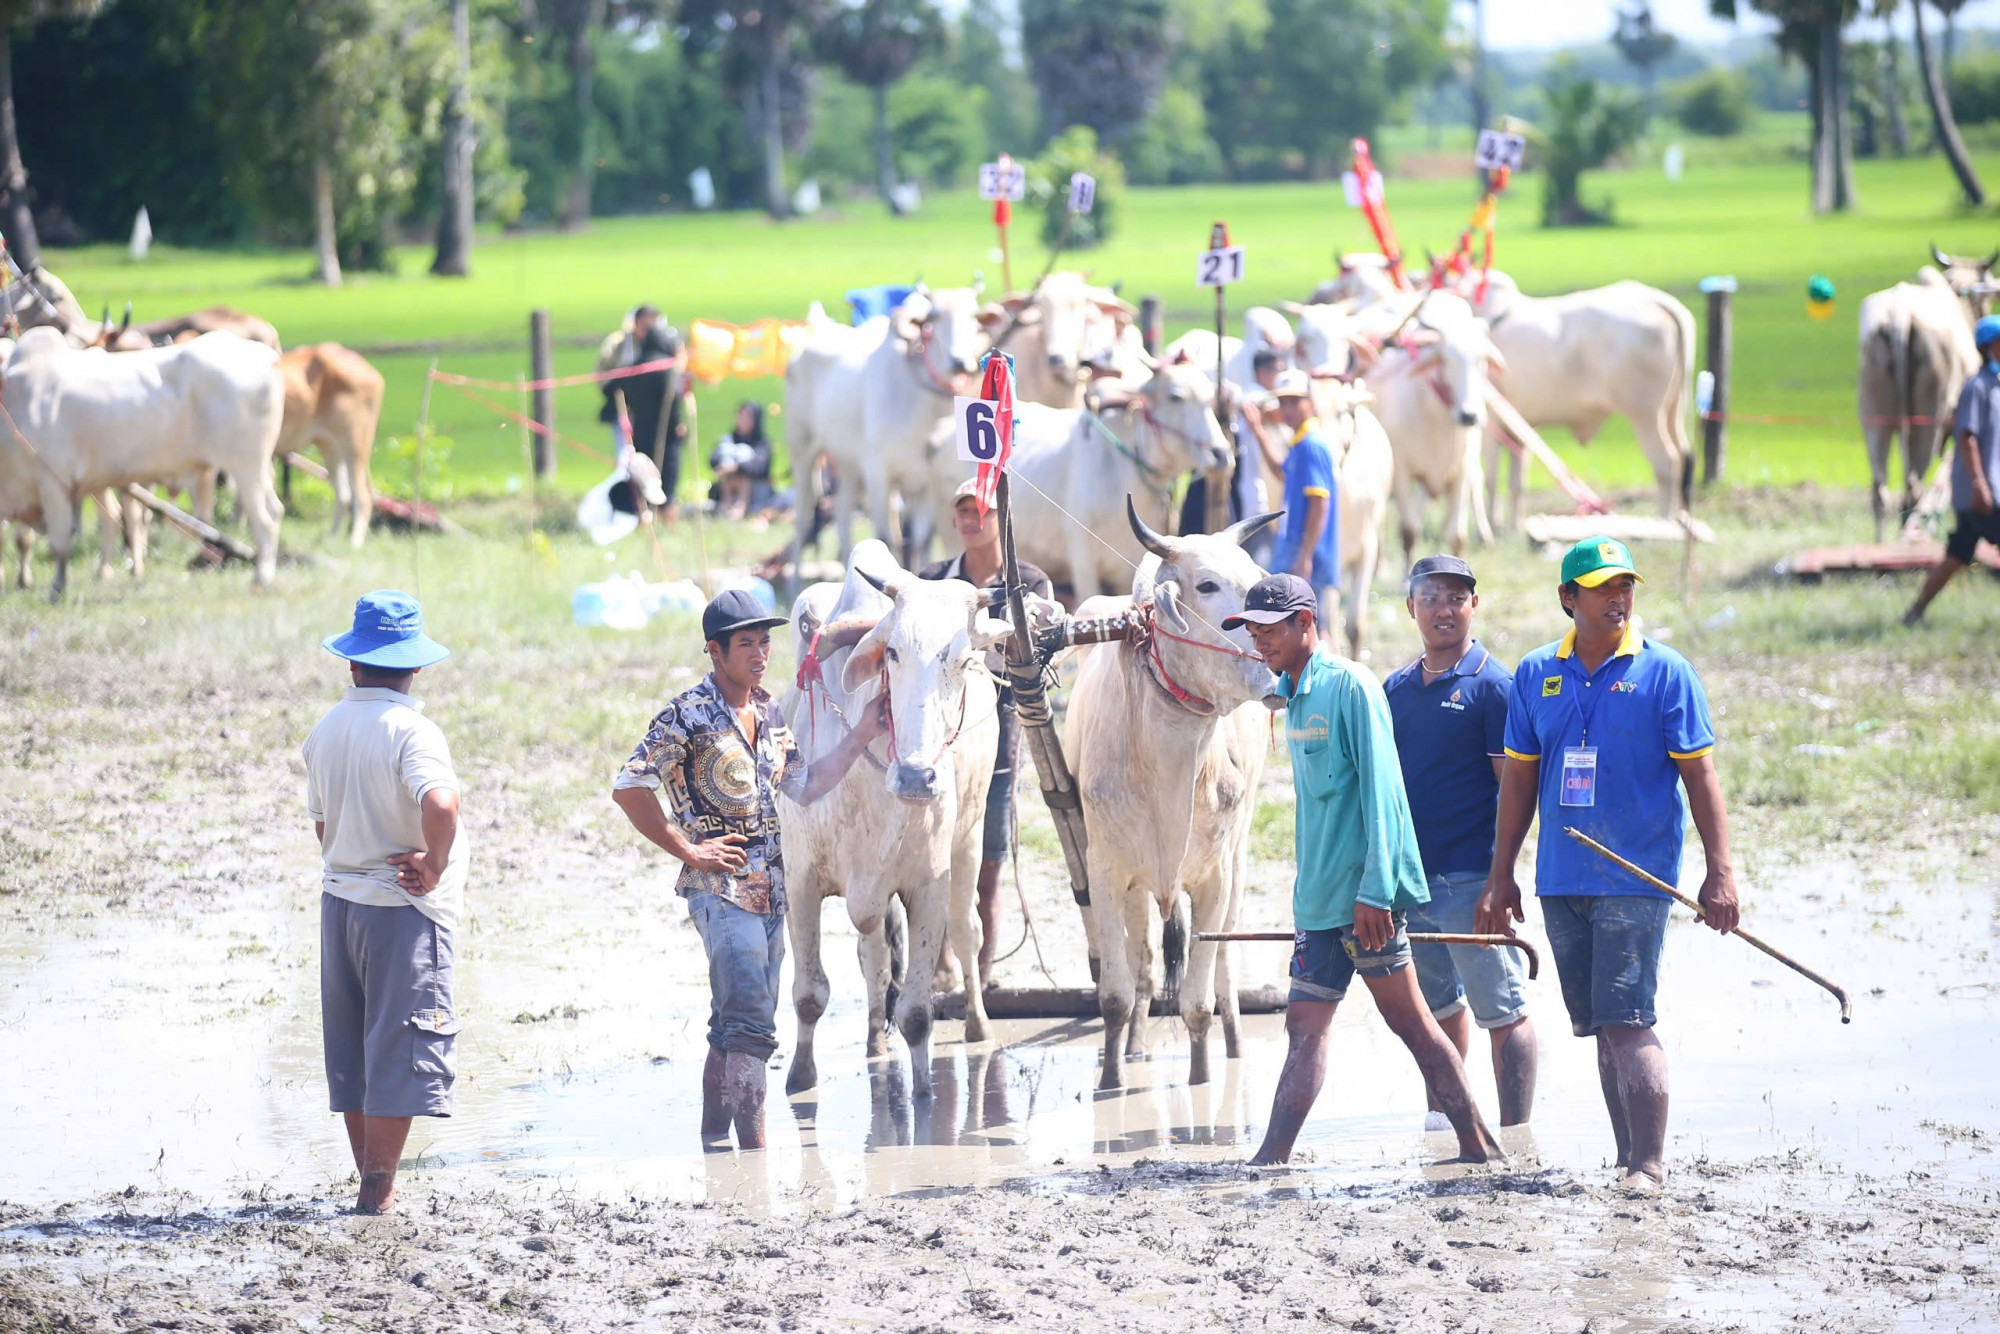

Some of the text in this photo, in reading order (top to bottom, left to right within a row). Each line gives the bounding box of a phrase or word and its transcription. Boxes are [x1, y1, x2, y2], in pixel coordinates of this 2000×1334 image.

[1203, 252, 1239, 282] 21
[966, 402, 997, 460] 6
[1611, 681, 1638, 693] ATV
